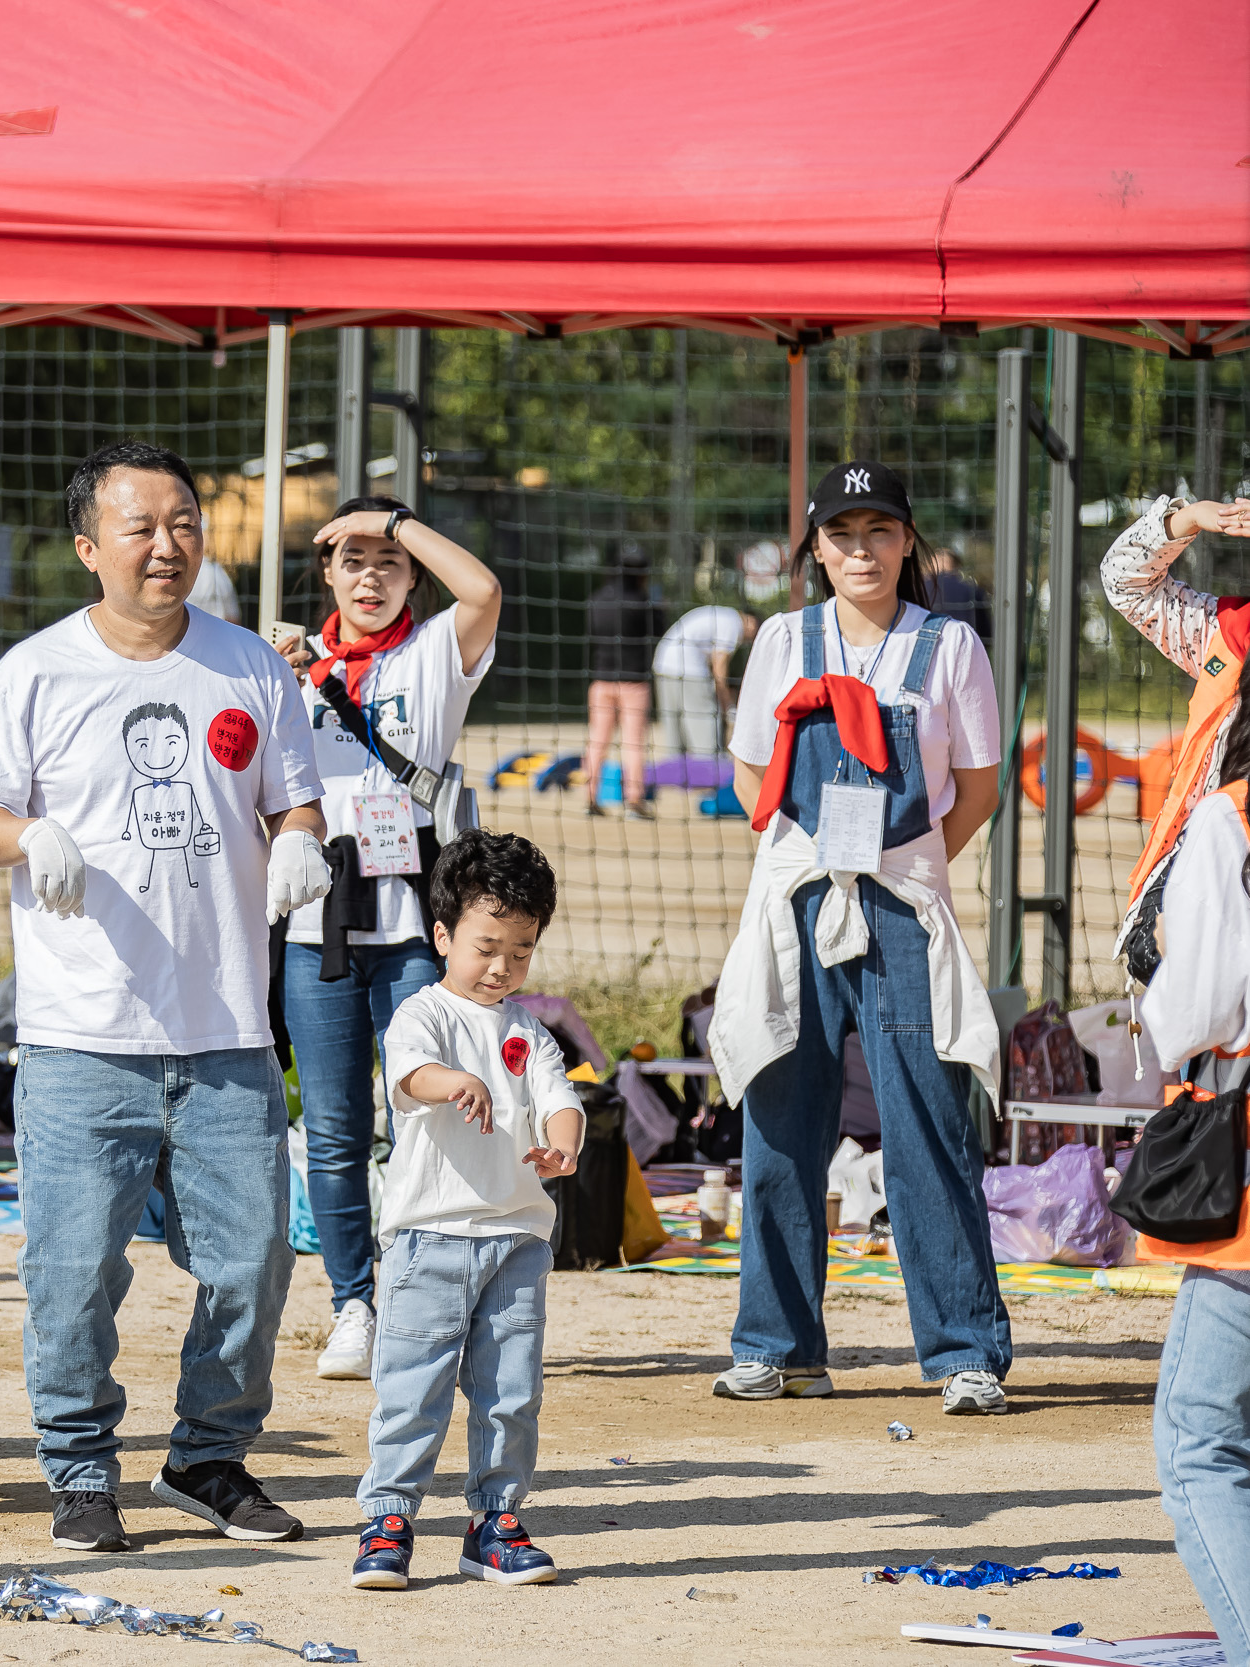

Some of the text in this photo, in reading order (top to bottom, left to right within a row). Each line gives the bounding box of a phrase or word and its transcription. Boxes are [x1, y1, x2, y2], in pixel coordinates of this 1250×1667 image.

[844, 468, 871, 494] NY
[224, 712, 249, 731] 중곡4동
[388, 726, 417, 738] GIRL
[151, 826, 181, 839] 아빠
